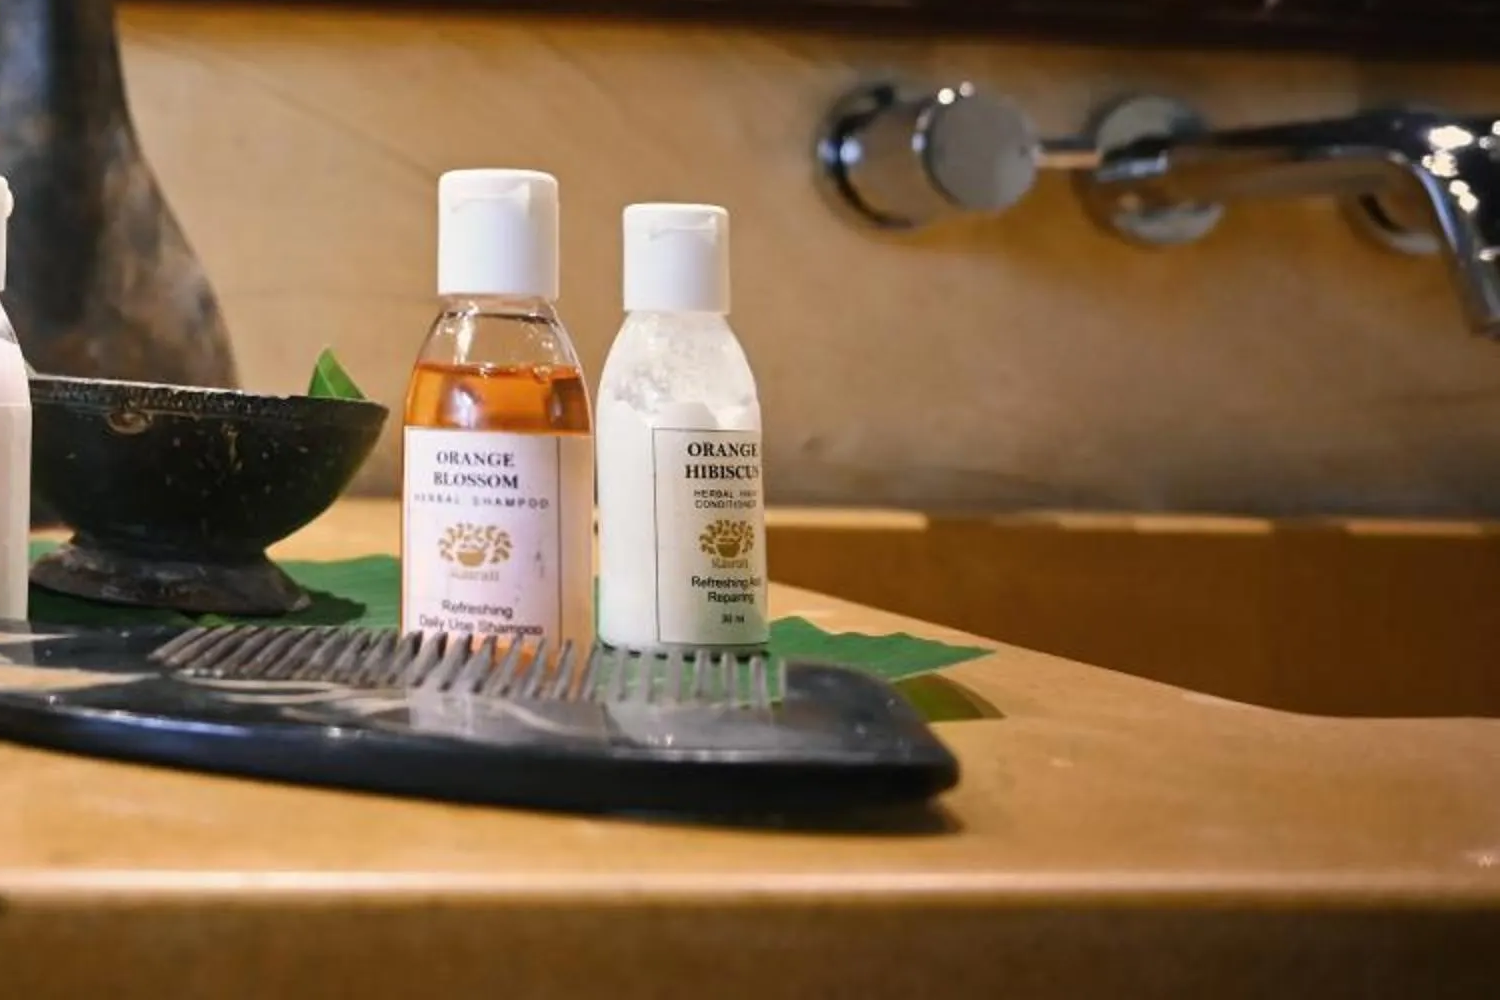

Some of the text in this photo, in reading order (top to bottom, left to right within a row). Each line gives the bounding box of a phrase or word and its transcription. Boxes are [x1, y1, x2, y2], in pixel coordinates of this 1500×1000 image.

[687, 442, 759, 457] ORANGE
[436, 451, 515, 468] ORANGE
[433, 471, 519, 490] BLOSSOM
[694, 489, 734, 498] HERBAL
[473, 497, 550, 510] SHAMPOO
[691, 576, 748, 590] Refreshing
[442, 599, 513, 619] Refreshing
[419, 614, 544, 637] Daily Use Shampoo
